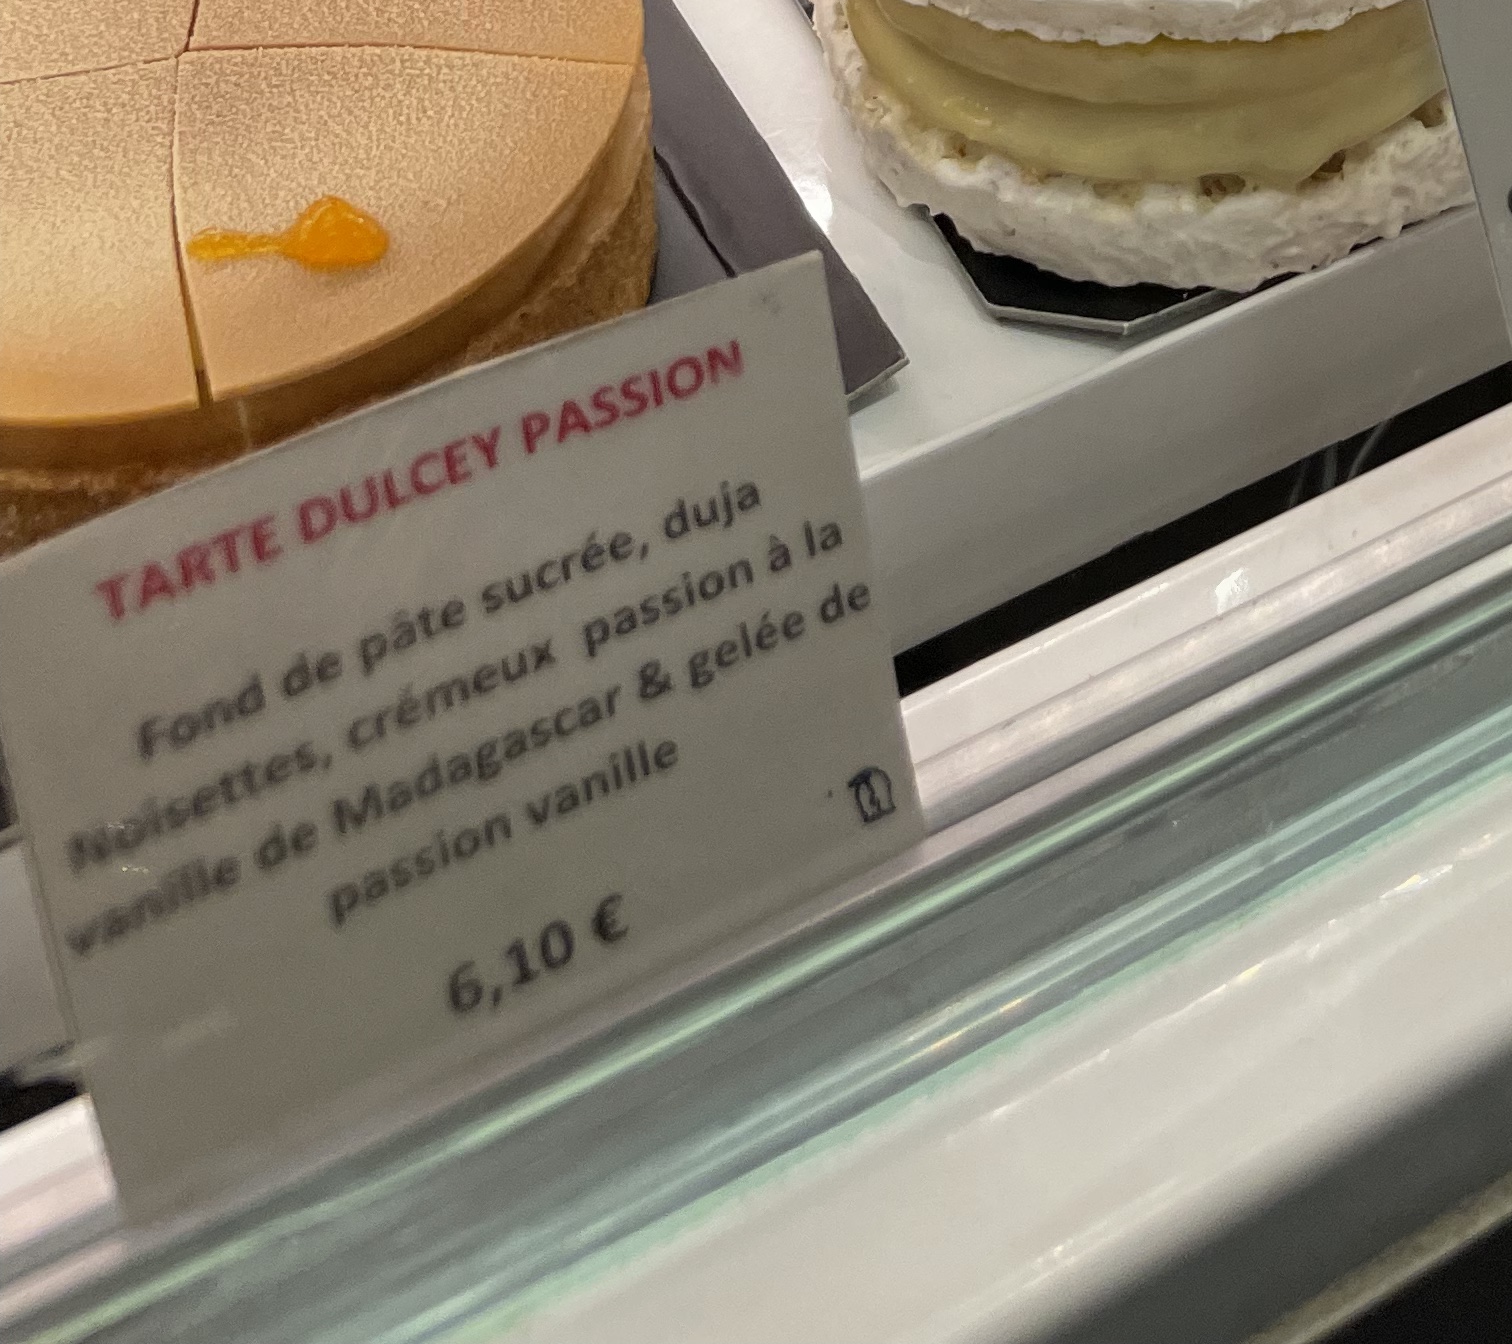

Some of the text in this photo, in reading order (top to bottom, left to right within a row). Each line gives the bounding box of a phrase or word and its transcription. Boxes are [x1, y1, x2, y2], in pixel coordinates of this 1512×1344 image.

[92, 341, 743, 626] TARTE DULCEY PASSION
[134, 483, 760, 765] Fond de pâte sucrée, duja
[255, 822, 317, 877] de
[330, 686, 620, 841] Madagascar
[637, 660, 675, 705] &
[687, 611, 804, 695] gelée
[817, 583, 869, 625] de
[345, 637, 557, 755] crémeux
[581, 560, 753, 661] passion
[768, 536, 791, 577] à
[803, 522, 843, 558] la
[326, 741, 677, 927] passion vanille
[448, 891, 630, 1014] 6,10 €
